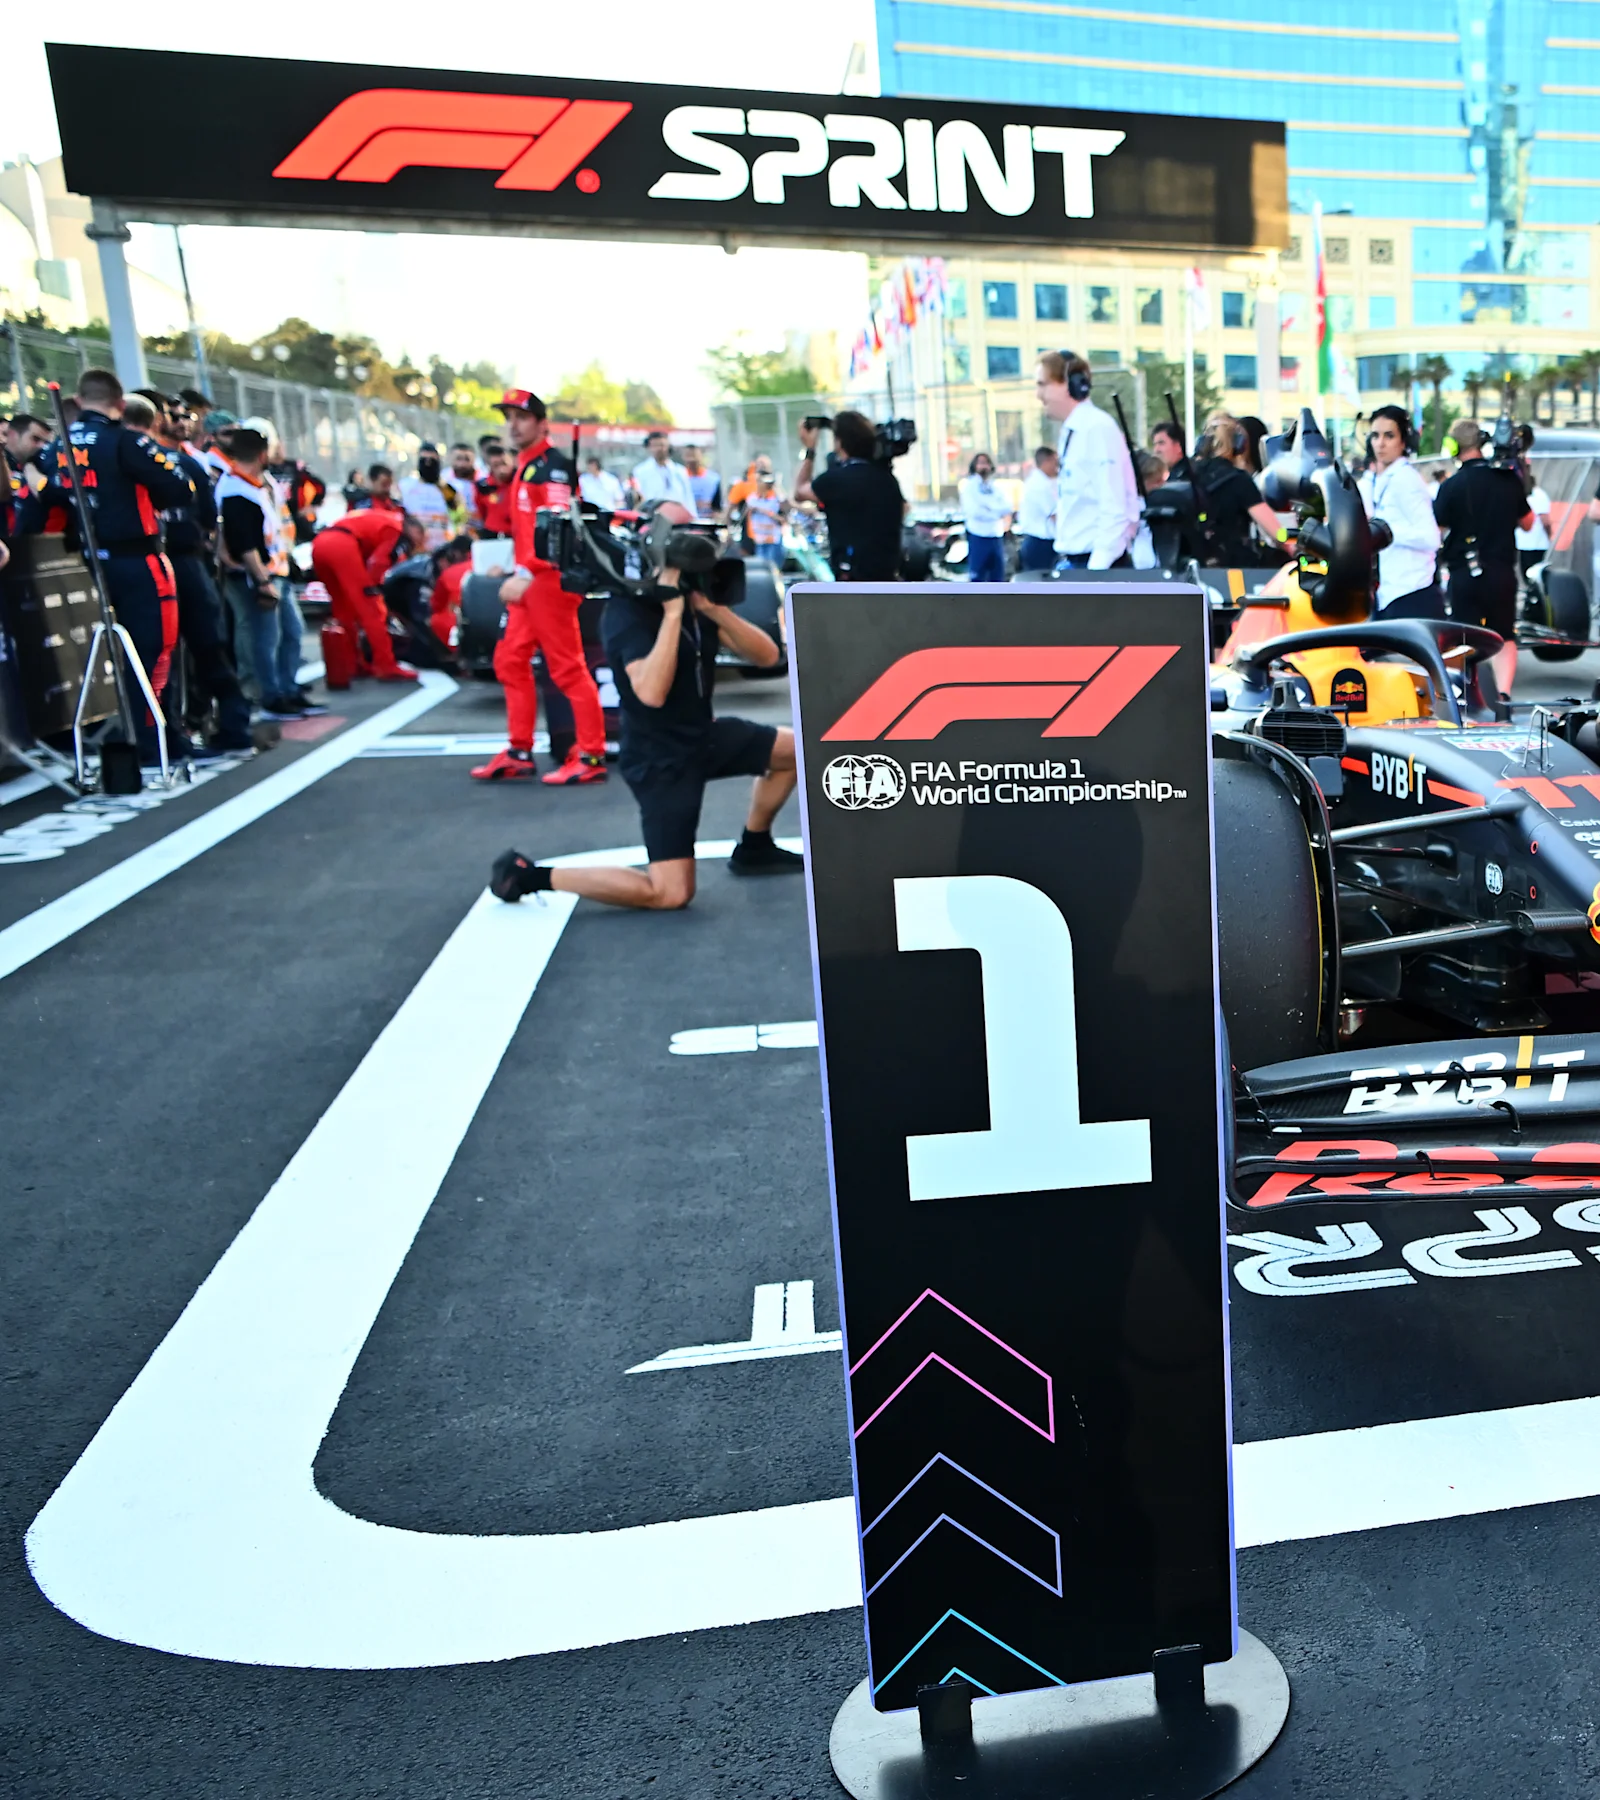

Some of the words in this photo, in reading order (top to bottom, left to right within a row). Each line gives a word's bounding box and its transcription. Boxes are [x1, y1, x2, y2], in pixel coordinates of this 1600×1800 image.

[271, 88, 633, 193] F1
[647, 104, 1127, 218] SPRINT
[820, 645, 1181, 741] F1
[1335, 693, 1350, 702] Red
[1350, 693, 1365, 702] Bull
[910, 761, 956, 783] FIA
[959, 759, 1067, 782] Formula
[1070, 758, 1086, 779] 1
[910, 783, 990, 806] World
[1371, 752, 1427, 805] BYBIT
[893, 874, 1153, 1201] 1
[1342, 1035, 1586, 1115] BYBIT
